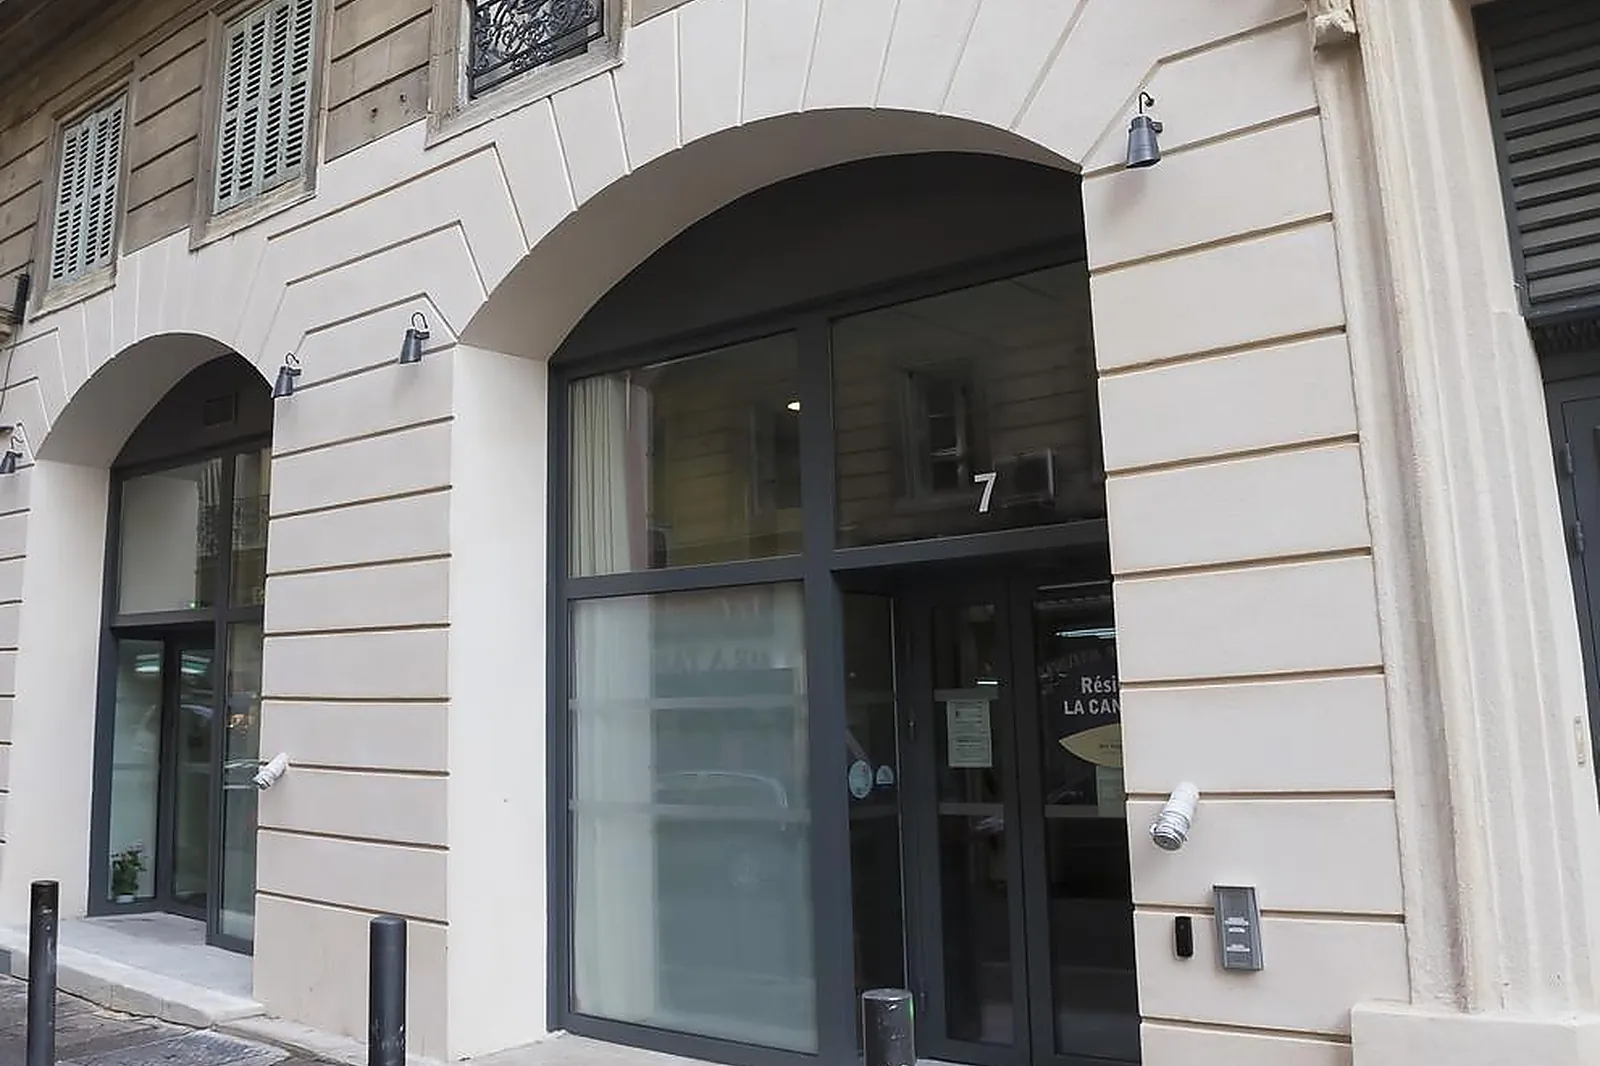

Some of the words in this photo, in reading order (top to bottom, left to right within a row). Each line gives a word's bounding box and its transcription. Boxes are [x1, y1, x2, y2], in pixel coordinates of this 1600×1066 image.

[973, 472, 997, 513] 7
[1081, 675, 1117, 694] Rési
[1064, 699, 1085, 715] LA
